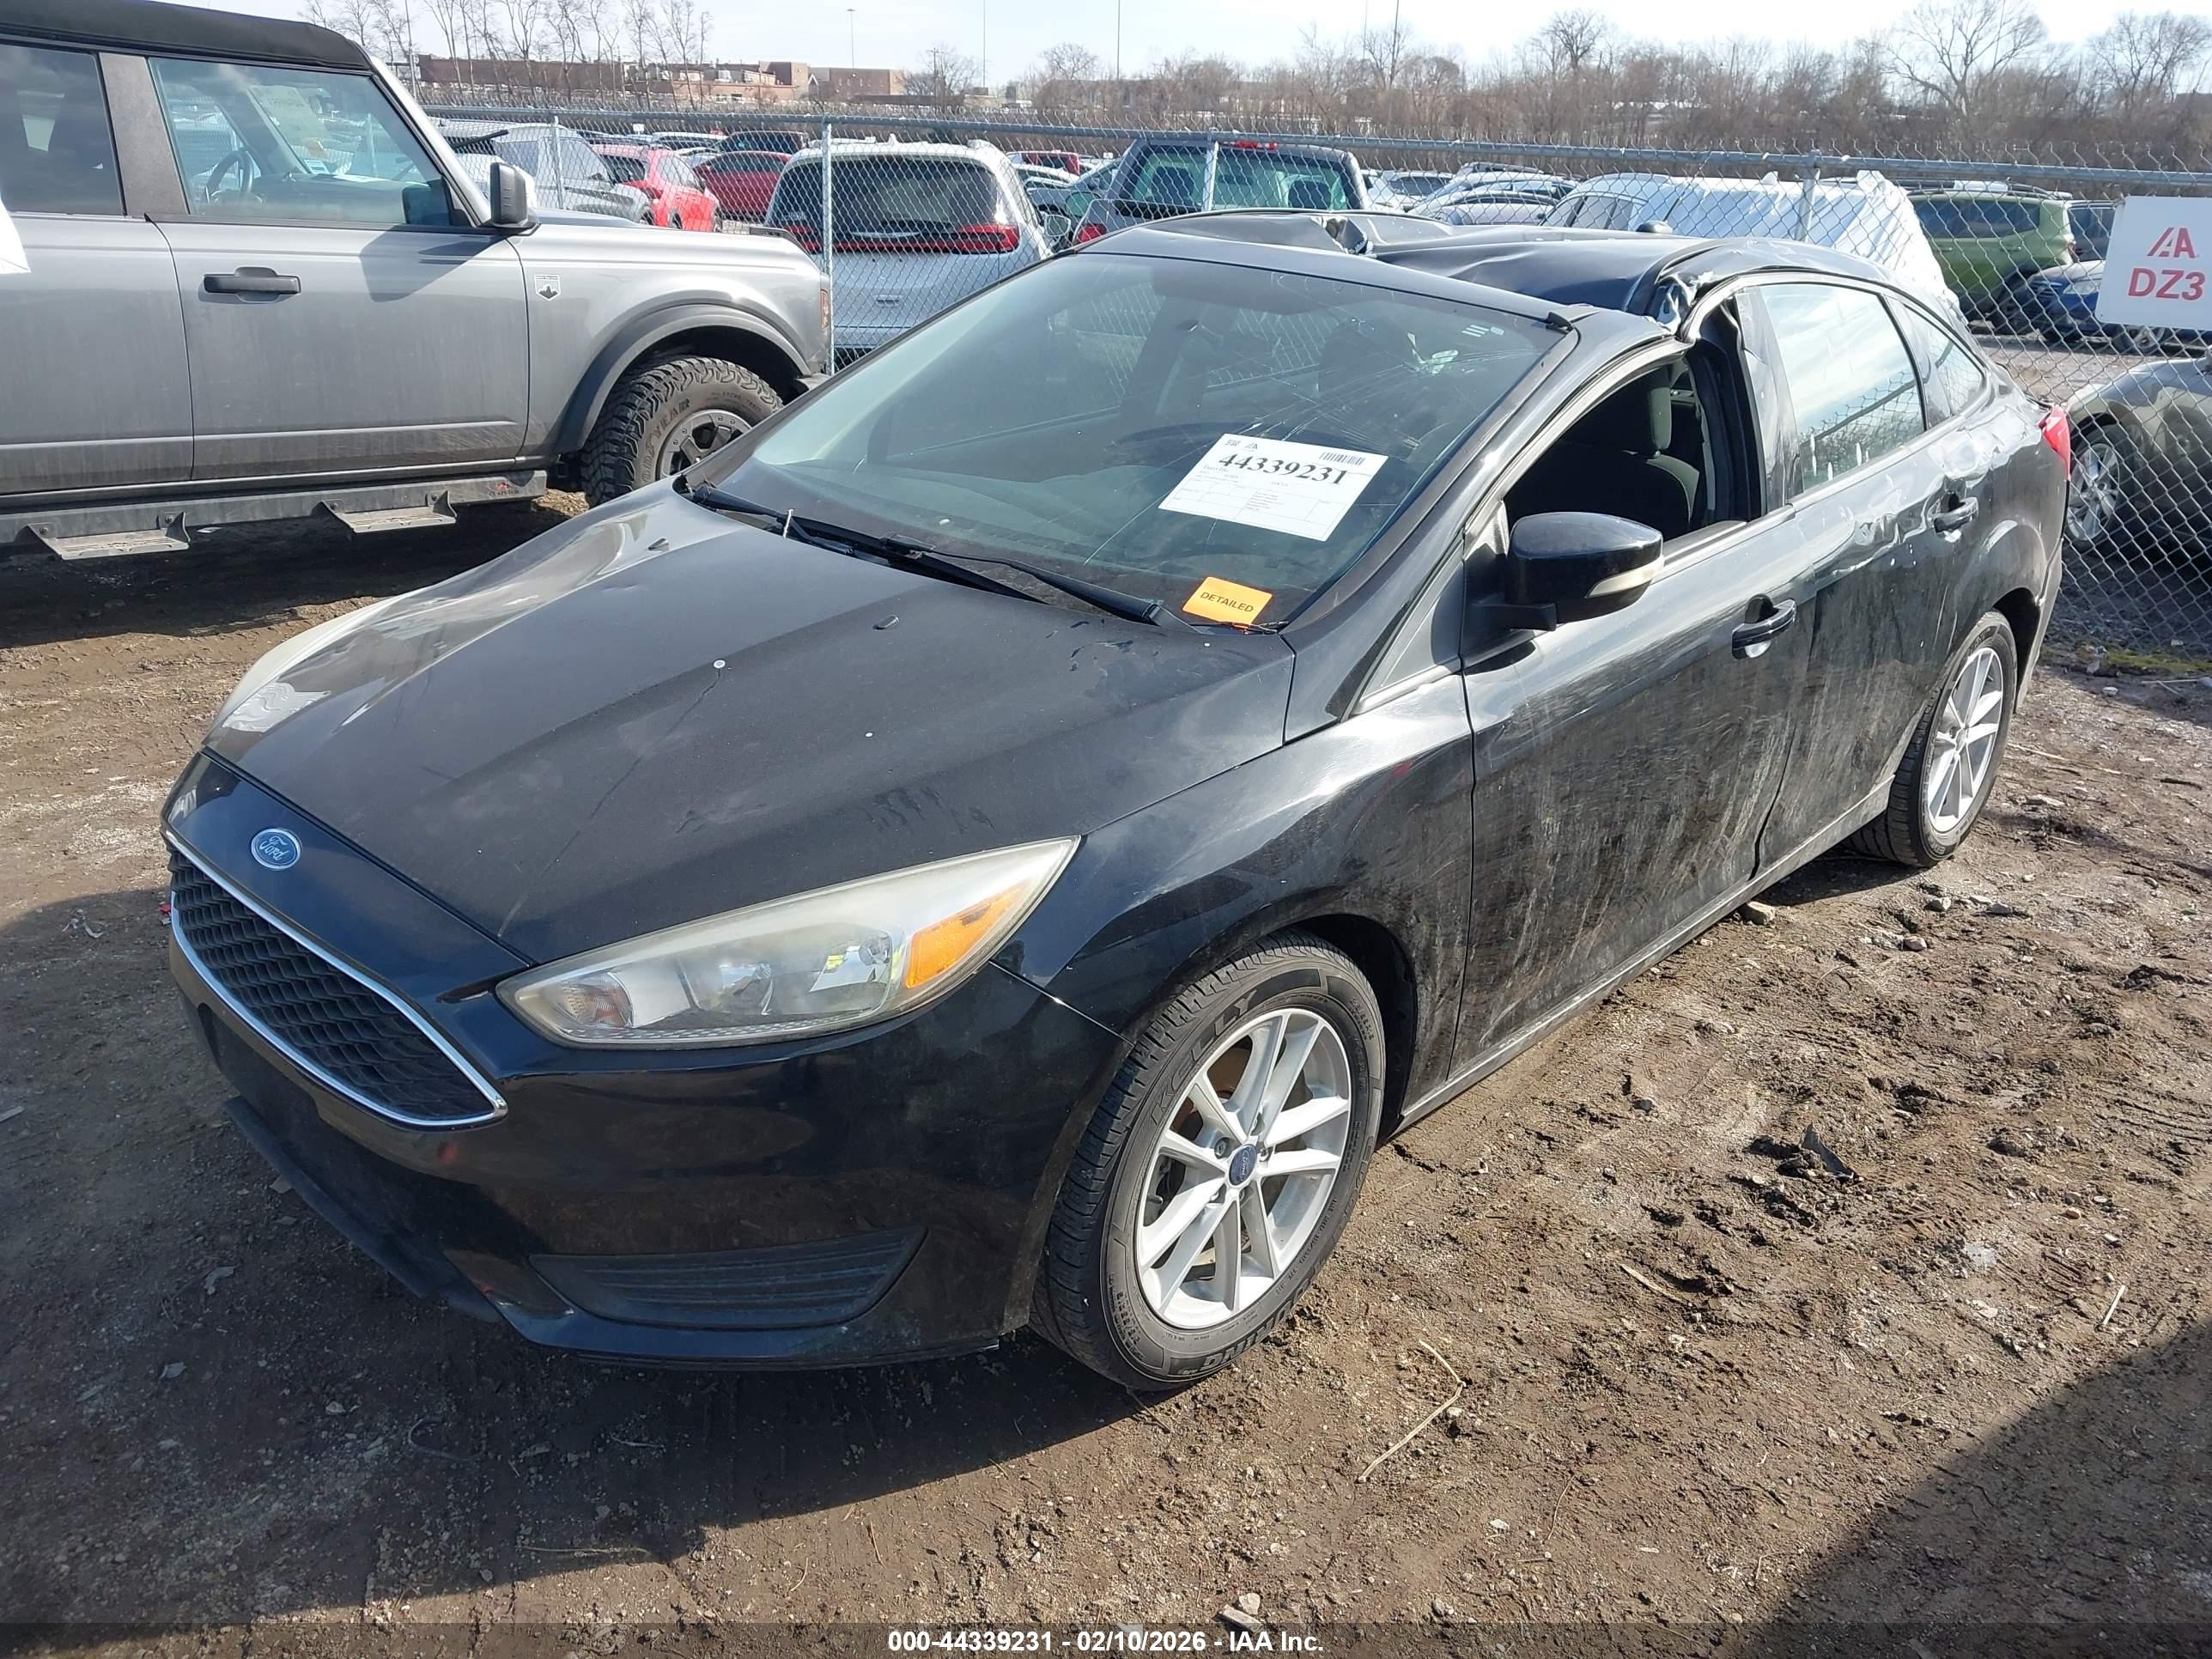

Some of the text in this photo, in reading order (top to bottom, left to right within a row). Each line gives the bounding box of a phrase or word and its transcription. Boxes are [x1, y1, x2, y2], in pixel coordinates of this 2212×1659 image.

[2128, 267, 2206, 301] DZ3
[1218, 453, 1351, 485] 44339231
[1200, 591, 1255, 613] DETAILED
[259, 836, 289, 861] Ford
[1150, 988, 1258, 1126] KELLY
[1240, 1149, 1251, 1176] Ford
